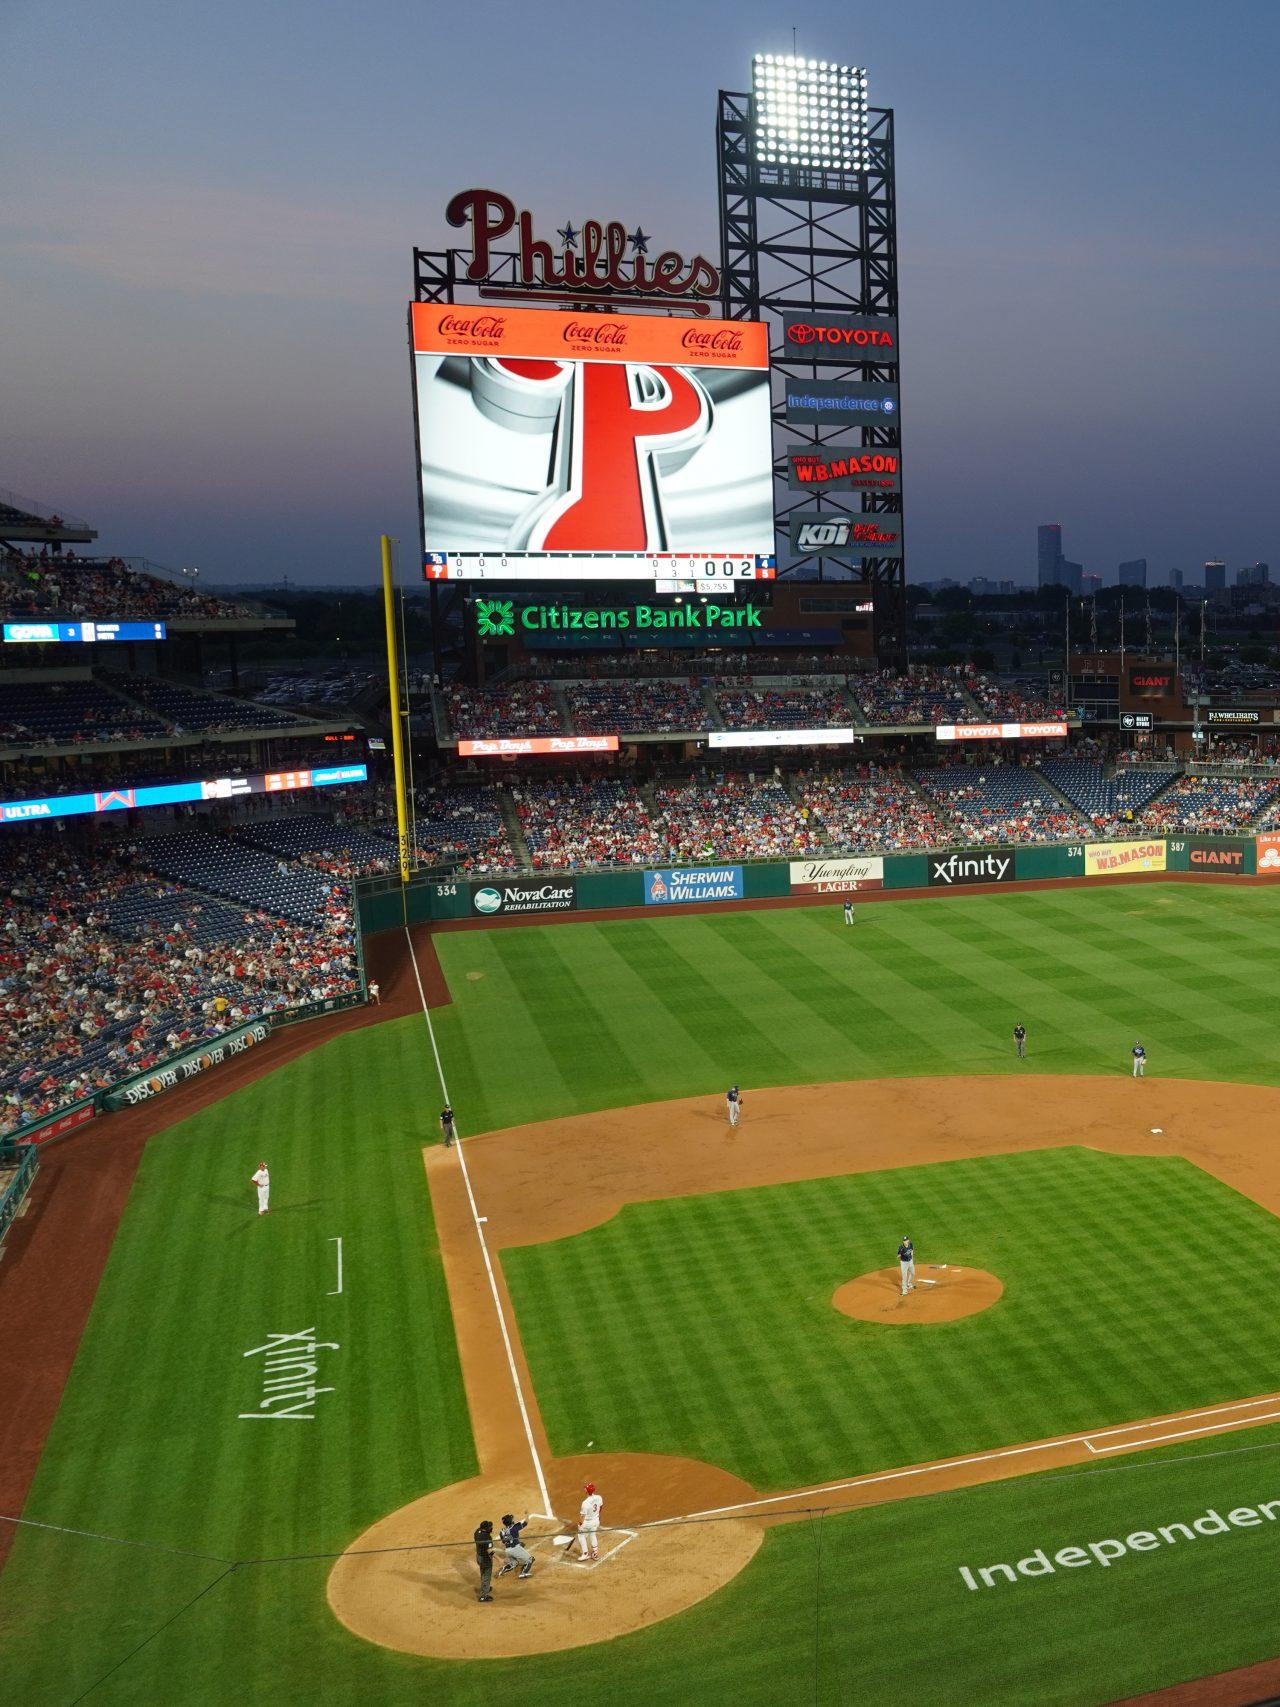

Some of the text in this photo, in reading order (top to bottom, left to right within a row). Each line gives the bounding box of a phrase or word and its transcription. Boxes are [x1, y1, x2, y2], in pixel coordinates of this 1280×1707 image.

[446, 188, 721, 296] Phillies
[438, 314, 507, 338] Coca-Cola
[563, 321, 629, 345] Coca-Cola
[681, 328, 745, 350] Coca-Cola
[815, 327, 893, 347] TOYOTA
[787, 394, 879, 411] Independence
[705, 561, 751, 577] 0 0 2
[521, 603, 762, 630] Citizens Bank Park
[1133, 675, 1170, 686] GIANT
[958, 726, 1064, 736] TOYOTA TOYOTA
[500, 740, 532, 751] Boys
[577, 737, 608, 748] Boys
[5, 804, 51, 818] ULTRA
[1068, 847, 1082, 857] 374
[1088, 850, 1101, 858] WHO
[1170, 842, 1185, 852] 387
[1190, 850, 1243, 865] GIANT
[802, 861, 873, 882] Yuengling
[933, 854, 1011, 883] xfinity
[670, 870, 734, 886] SHERWIN
[437, 885, 457, 897] 334
[503, 885, 573, 903] NovaCare
[669, 885, 738, 900] WILLIAMS.
[817, 880, 858, 893] LAGER
[504, 901, 571, 911] REHABILITATION
[228, 1026, 267, 1056] DISCOVER
[182, 1048, 225, 1078] DISCOVER
[126, 1070, 178, 1104] DISCOVER
[238, 1327, 340, 1419] xfinity
